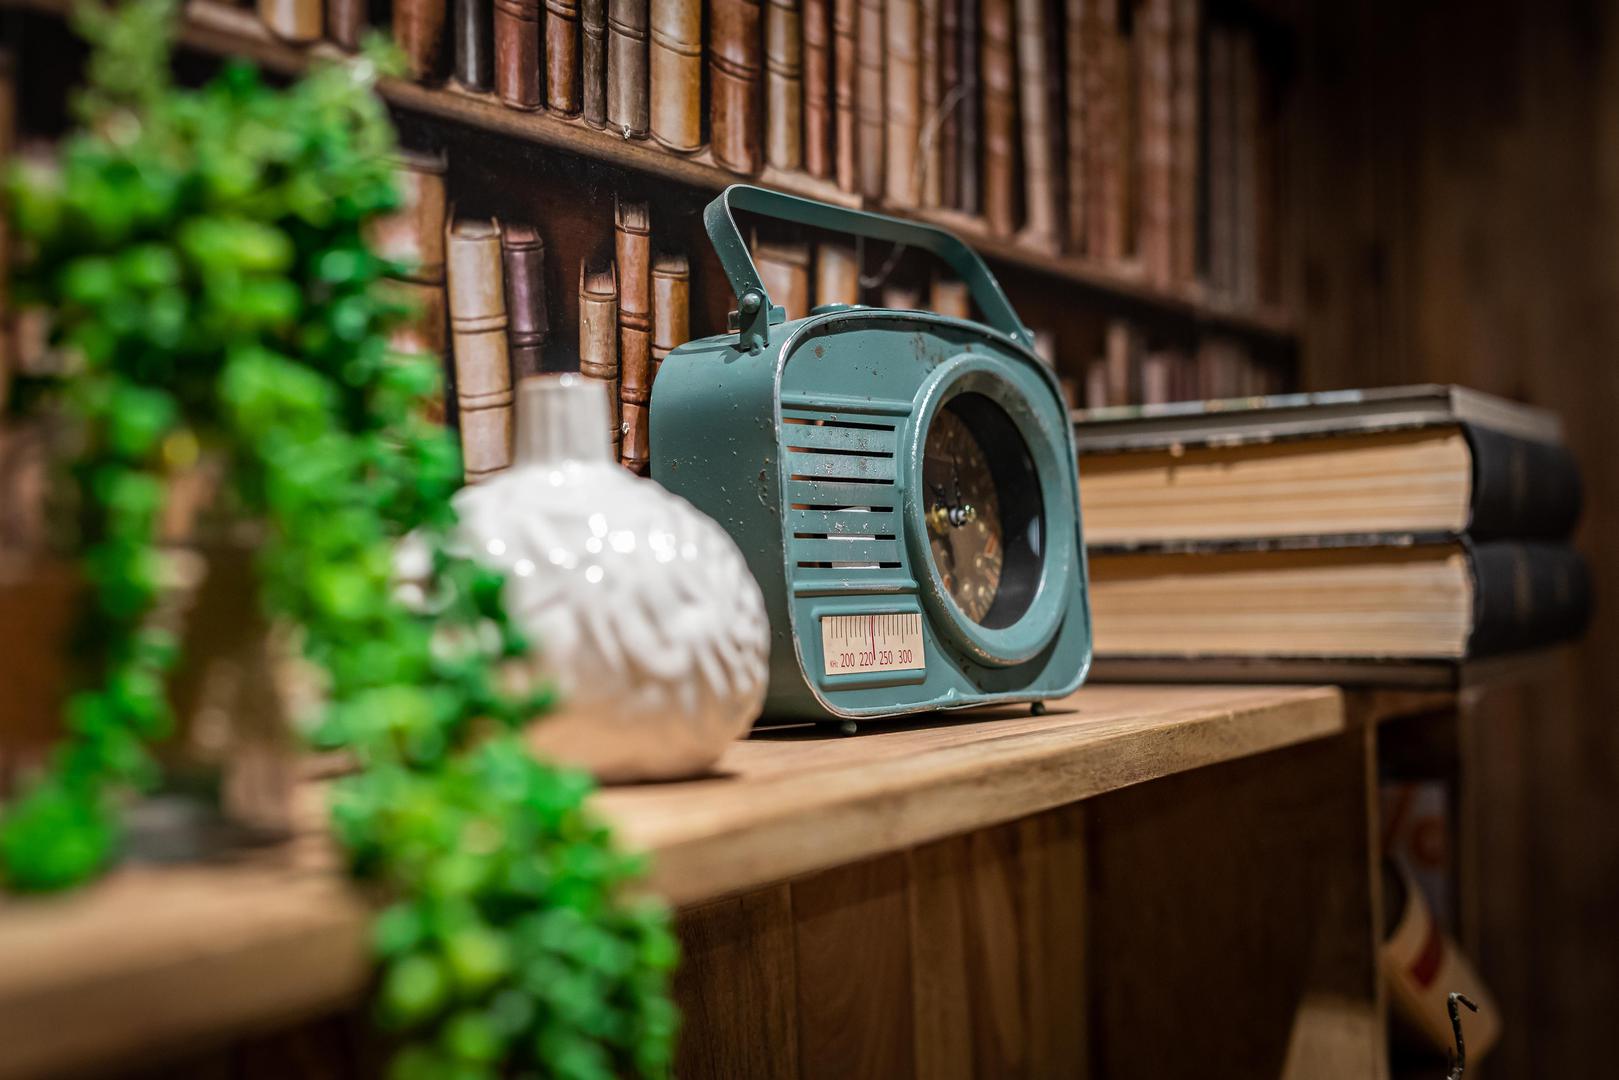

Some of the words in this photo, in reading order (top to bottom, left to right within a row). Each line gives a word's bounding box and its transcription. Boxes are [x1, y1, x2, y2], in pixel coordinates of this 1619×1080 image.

[840, 653, 855, 667] 200
[859, 652, 874, 666] 220
[879, 651, 893, 665] 250
[898, 649, 912, 664] 300
